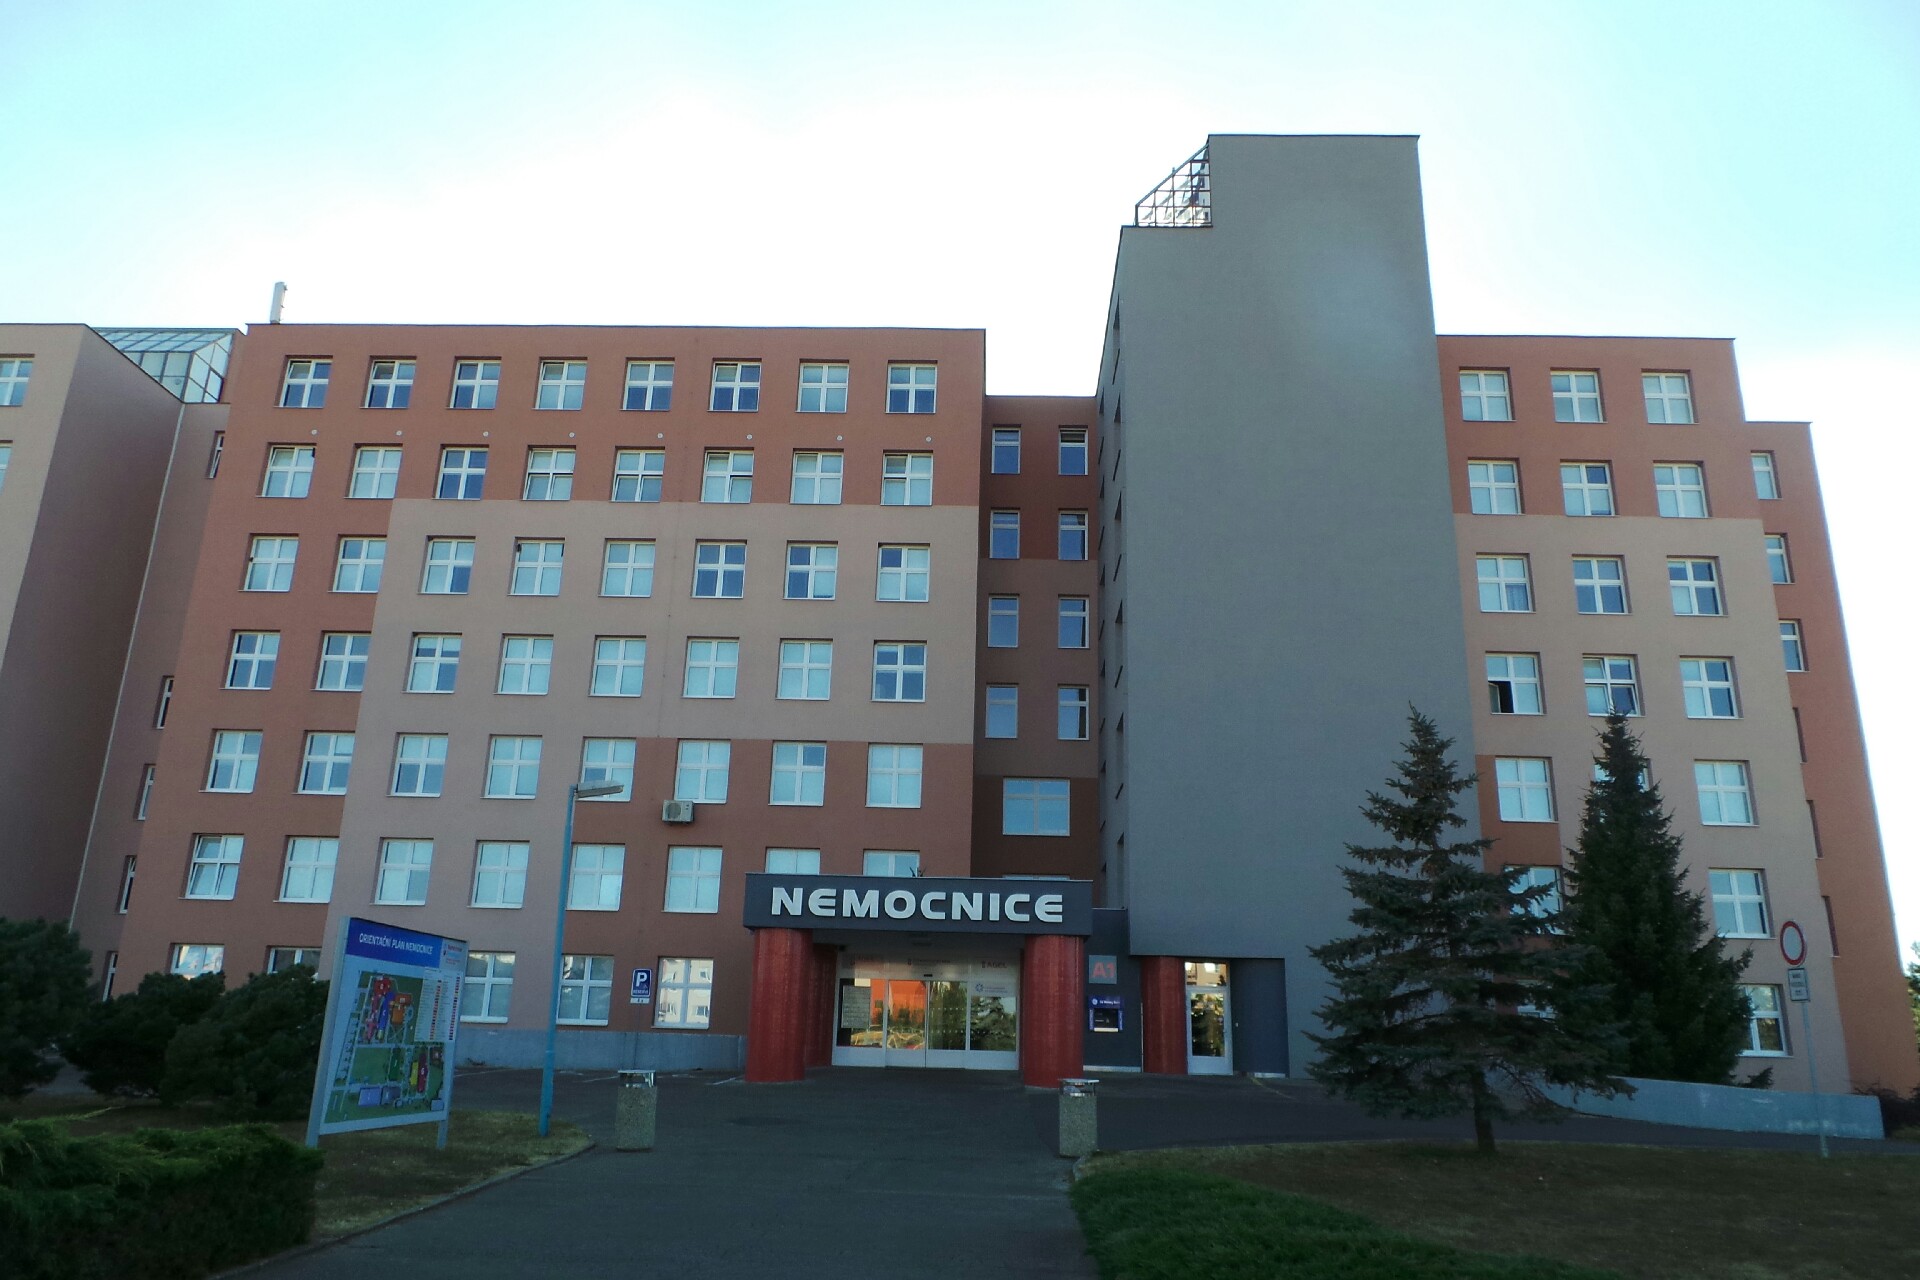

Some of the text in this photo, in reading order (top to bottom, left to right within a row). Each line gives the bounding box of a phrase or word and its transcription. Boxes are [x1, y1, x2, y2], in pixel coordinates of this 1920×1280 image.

[771, 887, 1063, 922] NEMOCNICE
[1093, 962, 1115, 977] A1
[636, 972, 648, 986] P
